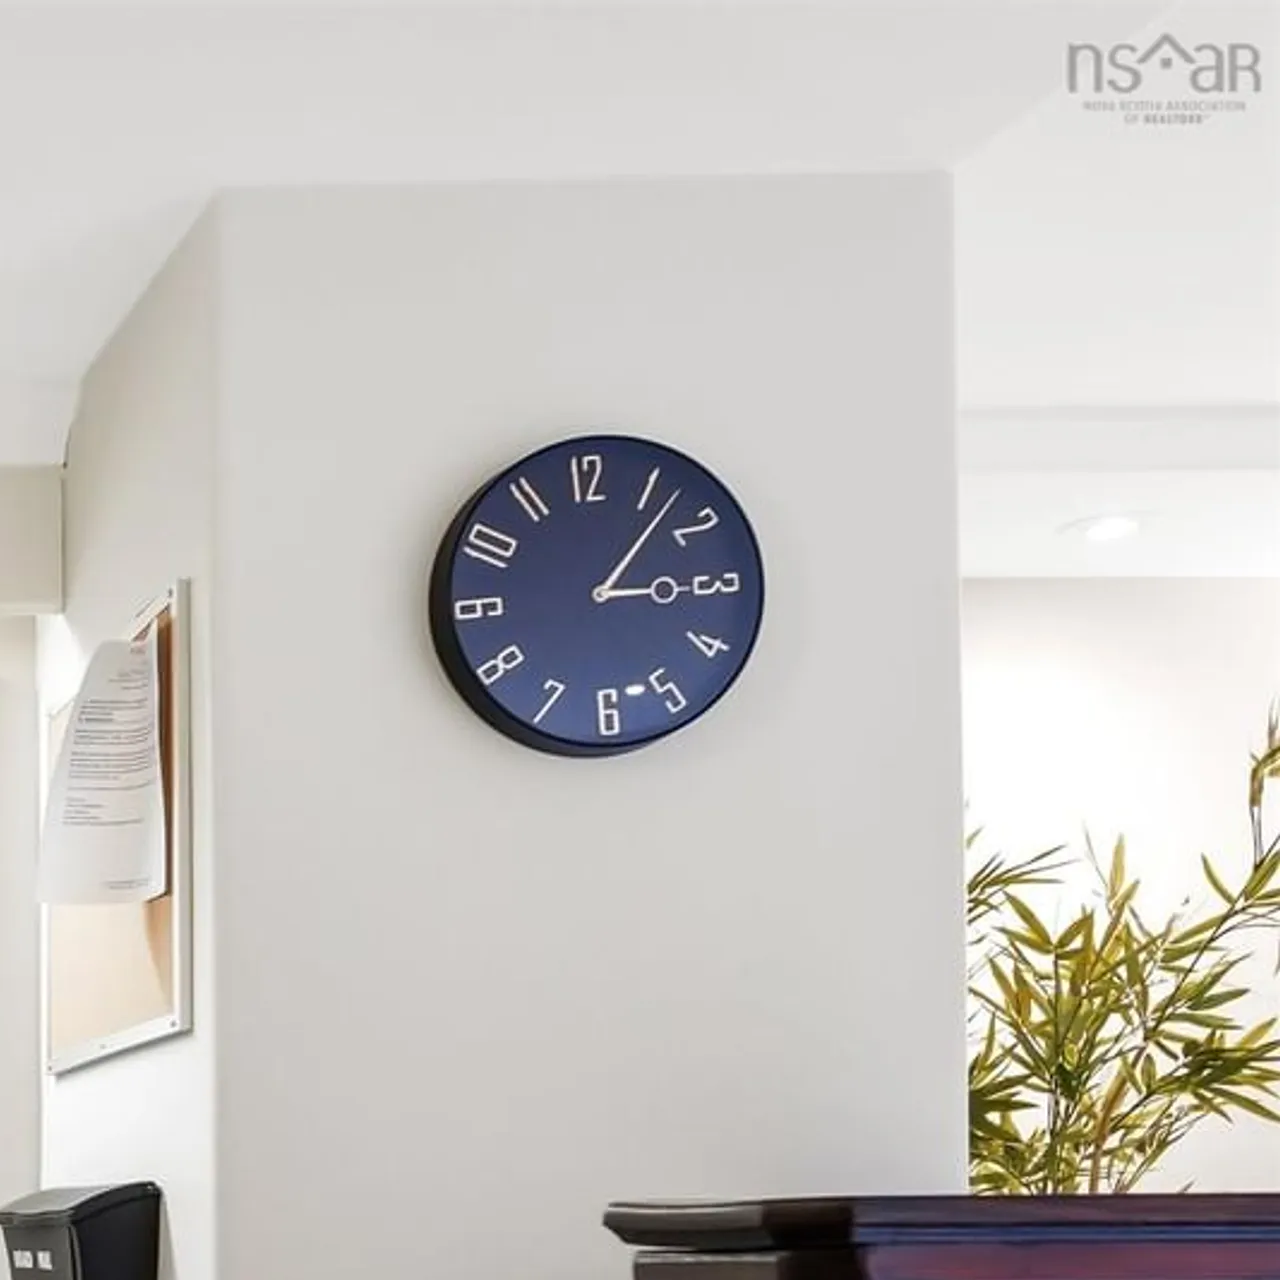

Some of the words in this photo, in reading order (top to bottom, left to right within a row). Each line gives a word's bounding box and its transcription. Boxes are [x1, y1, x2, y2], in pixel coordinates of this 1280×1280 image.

[510, 477, 550, 523] 11
[571, 456, 606, 503] 12
[637, 467, 660, 511] 1
[463, 523, 517, 568] 10
[673, 506, 720, 547] 2
[692, 573, 740, 595] 3
[454, 597, 504, 620] 9
[476, 645, 525, 686] 8
[686, 630, 730, 658] 4
[532, 678, 566, 725] 7
[596, 688, 621, 736] 6
[648, 667, 687, 714] 5
